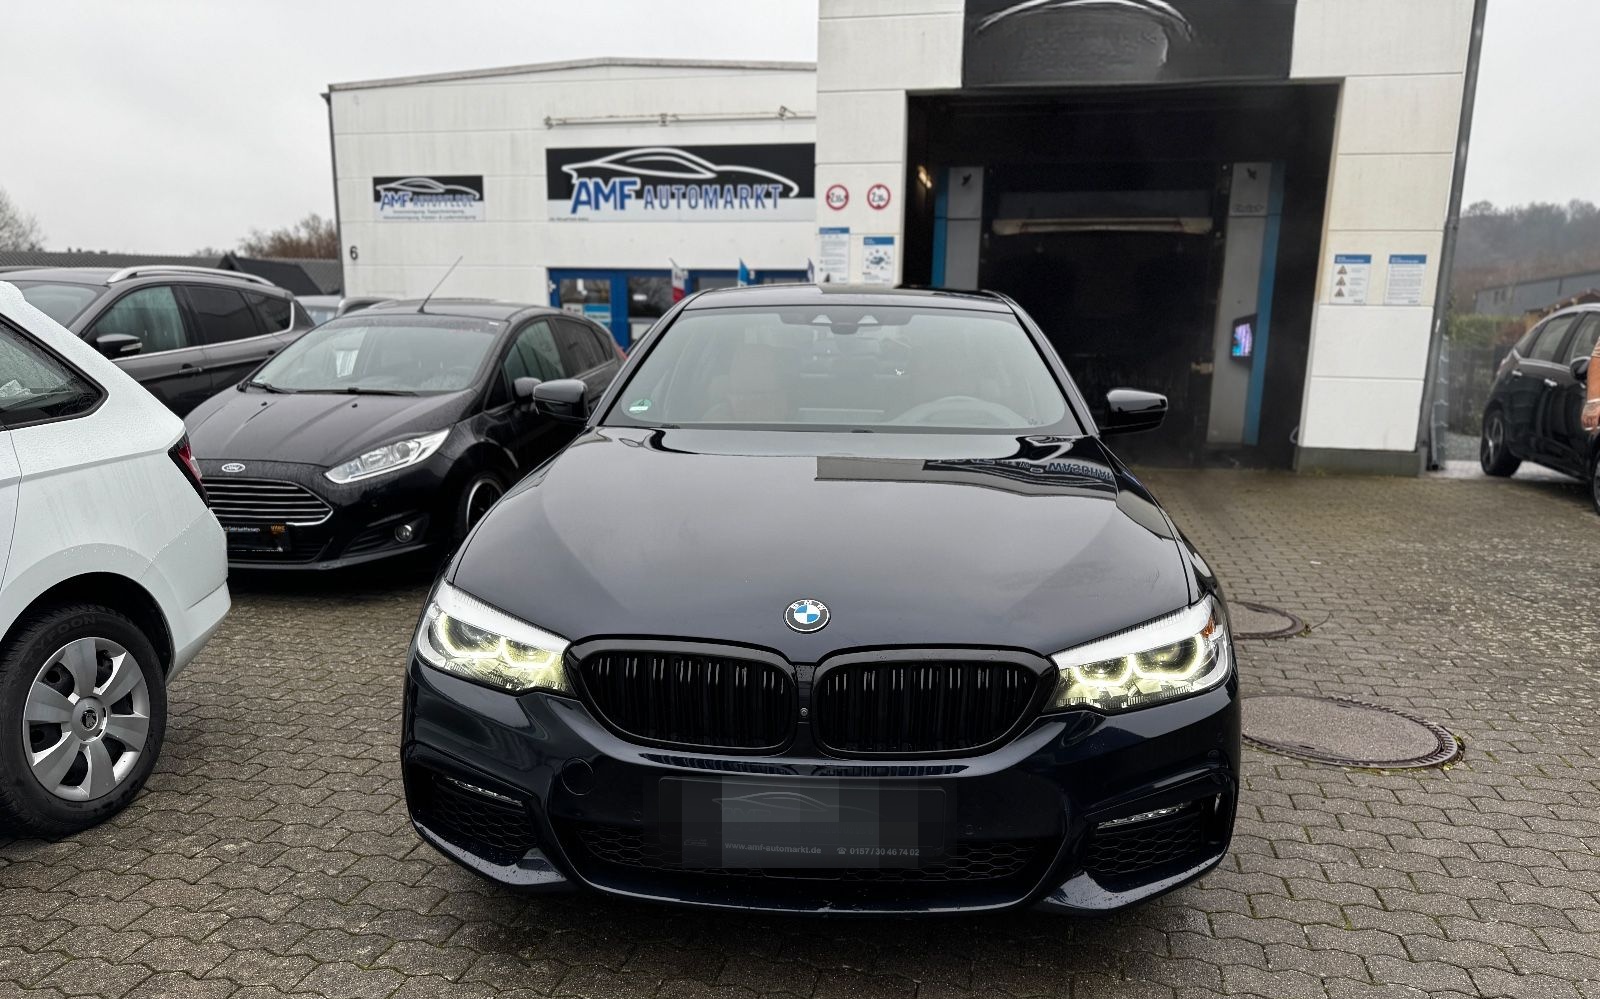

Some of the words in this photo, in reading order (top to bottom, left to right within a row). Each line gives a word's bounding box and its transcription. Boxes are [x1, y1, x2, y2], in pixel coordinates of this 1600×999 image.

[380, 191, 412, 211] AMF
[571, 178, 640, 214] AMF
[644, 184, 783, 210] AUTOMARKT
[349, 246, 359, 261] 6
[724, 842, 822, 854] www.amf-automarkt.de
[849, 847, 870, 855] 0157
[886, 848, 897, 856] 46
[898, 848, 908, 856] 74
[909, 848, 920, 856] 02
